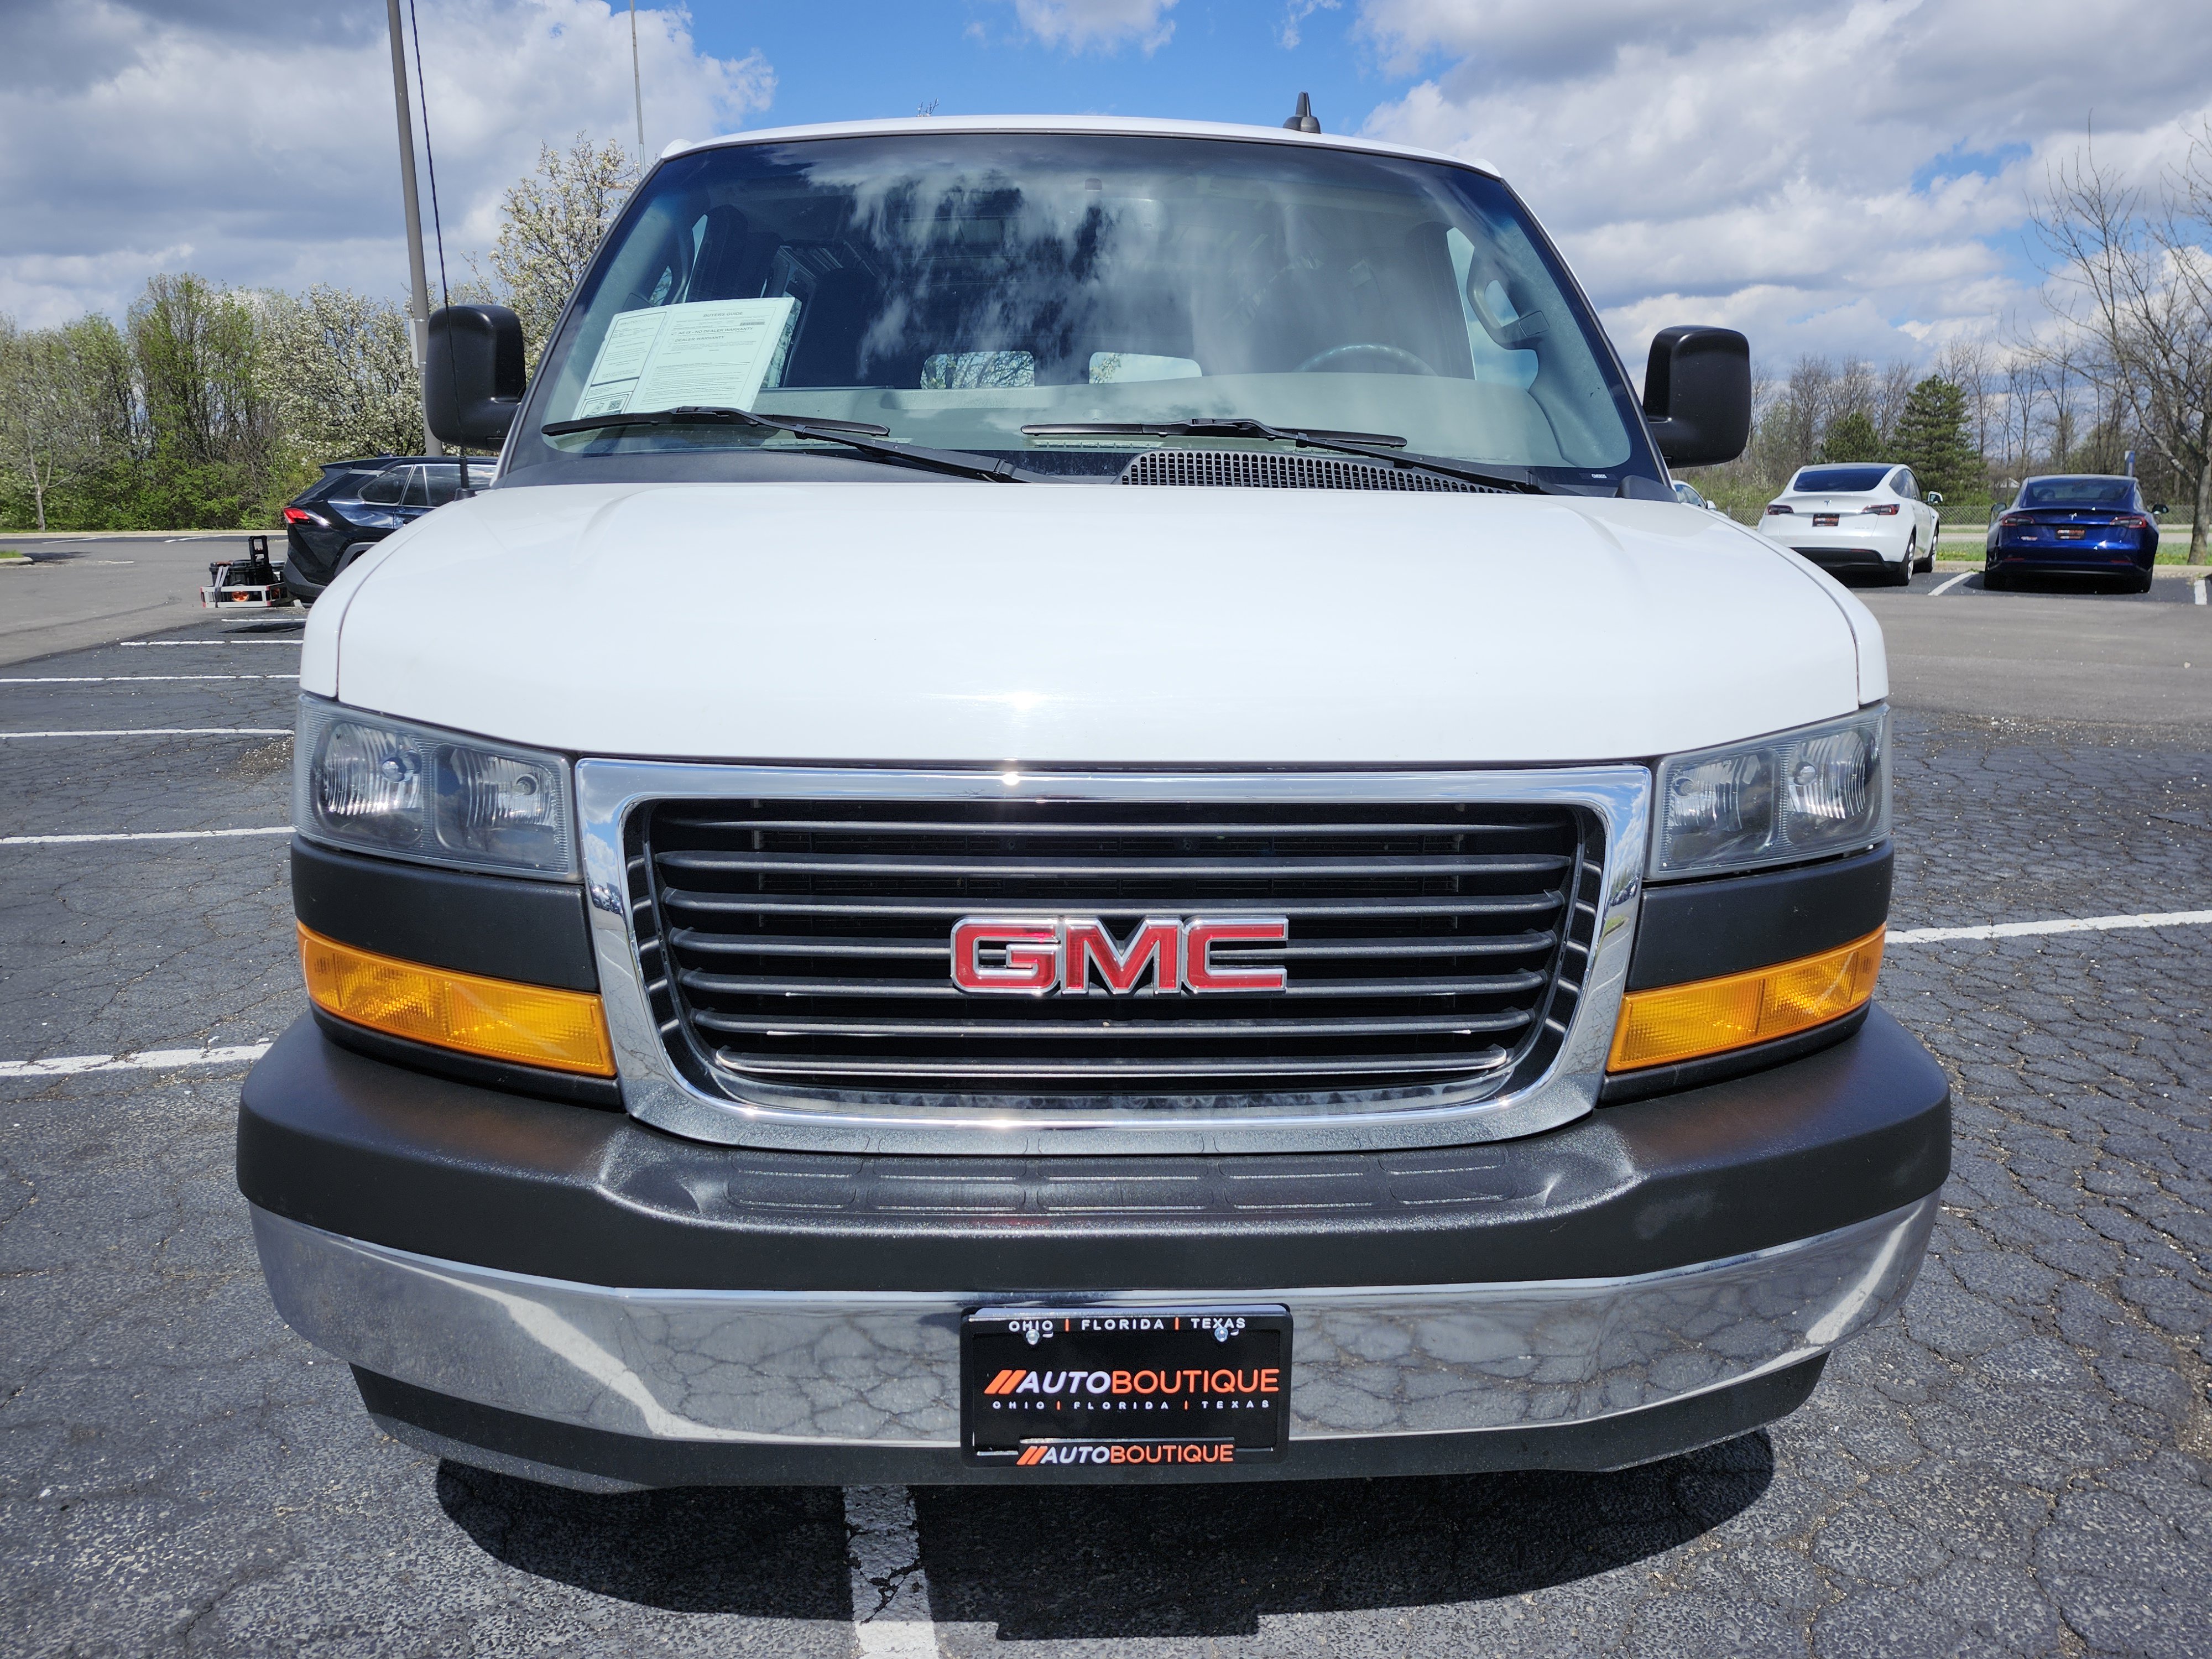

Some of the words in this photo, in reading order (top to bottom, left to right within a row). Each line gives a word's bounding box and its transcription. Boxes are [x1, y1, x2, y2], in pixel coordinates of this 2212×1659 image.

[951, 916, 1288, 994] GMC
[1008, 1319, 1053, 1332] OHIO
[1081, 1318, 1164, 1331] FLORIDA
[1191, 1317, 1246, 1329] TEXAS
[1016, 1369, 1280, 1394] AUTOBOUTIQUE
[992, 1401, 1046, 1410] OHIO
[1073, 1400, 1169, 1410] FLORIDA
[1202, 1400, 1270, 1408] TEXAS
[1040, 1444, 1234, 1464] AUTOBOUTIQUE
